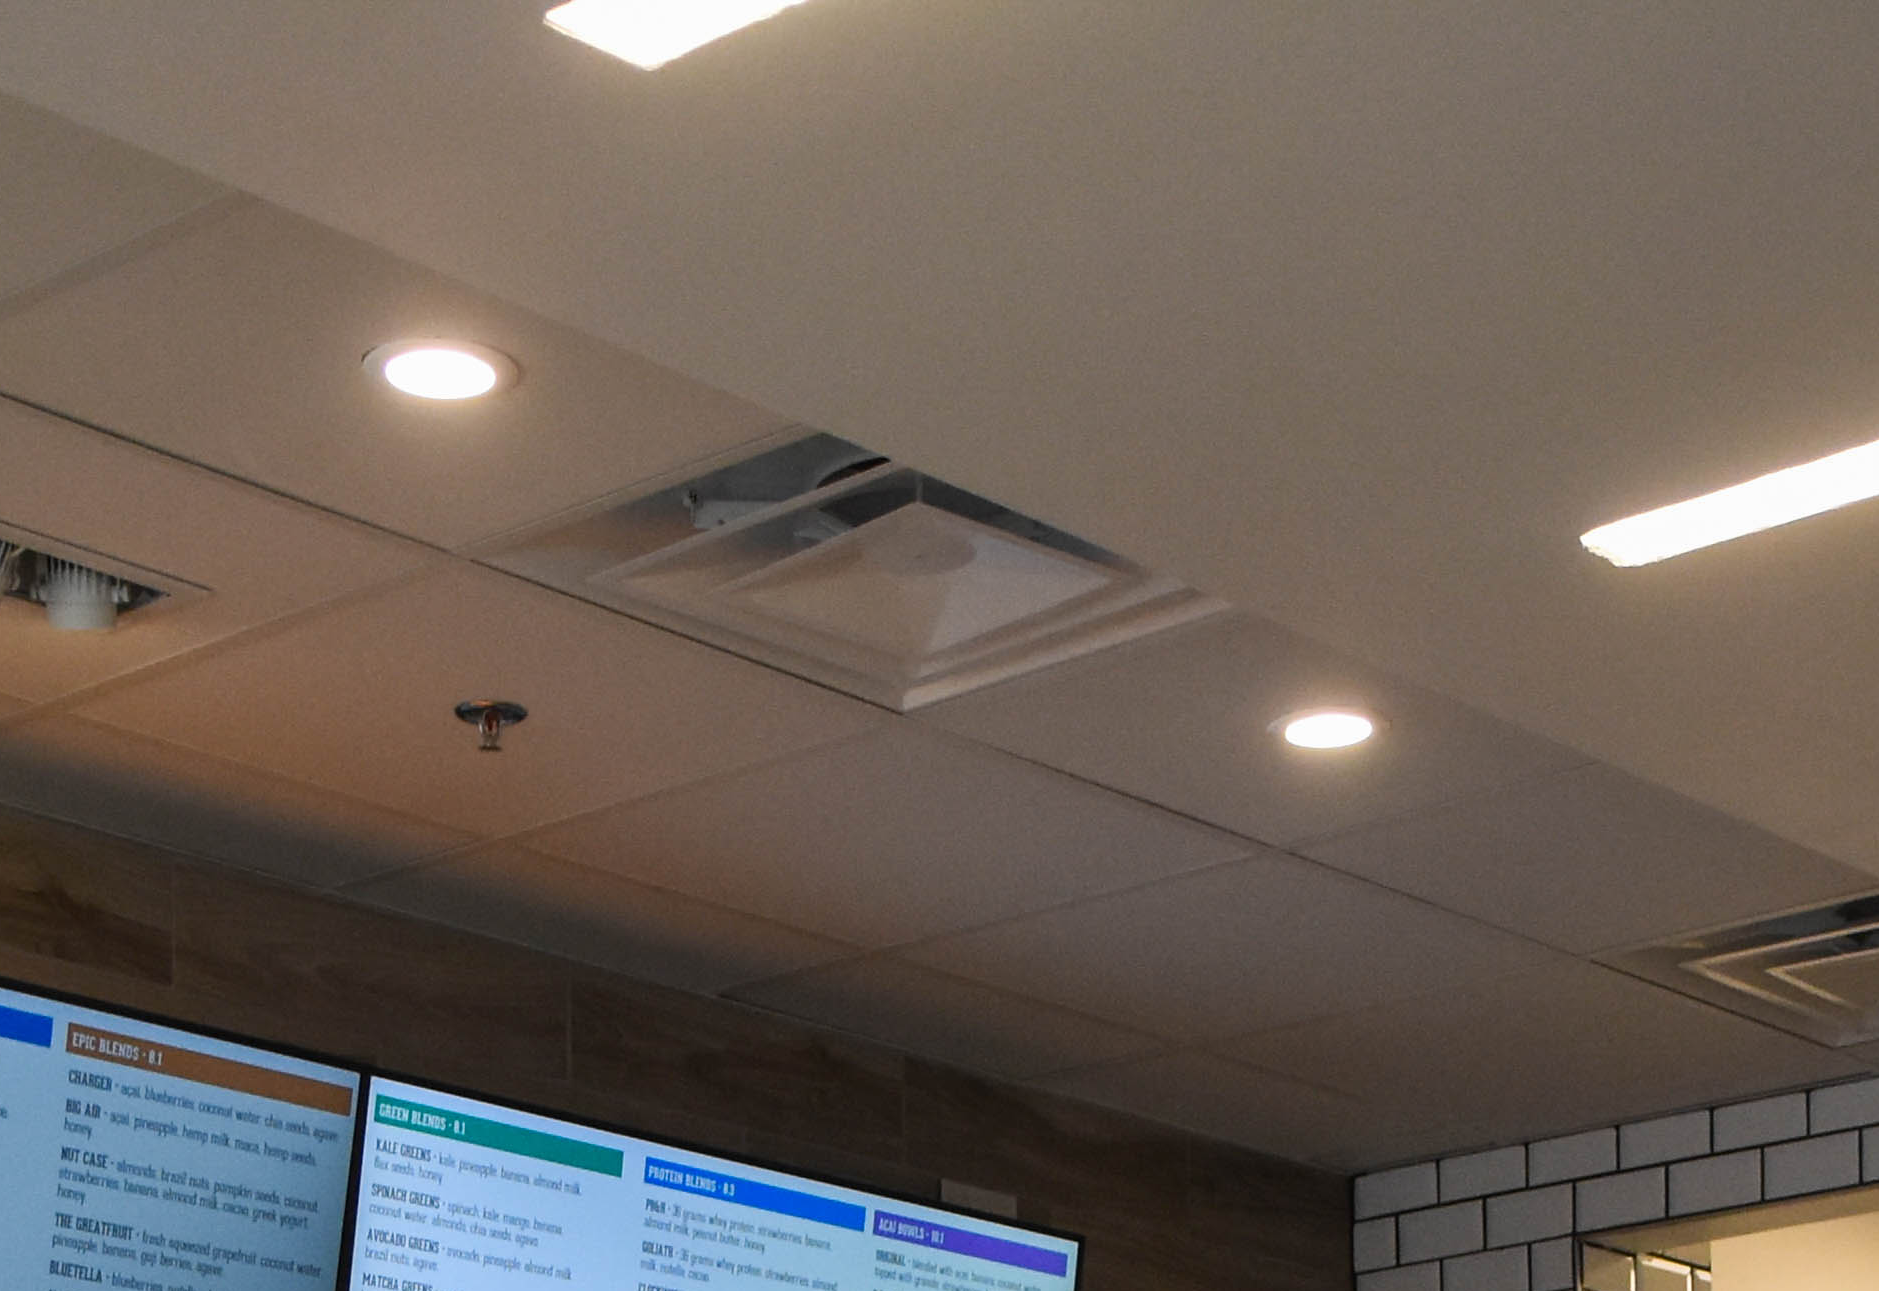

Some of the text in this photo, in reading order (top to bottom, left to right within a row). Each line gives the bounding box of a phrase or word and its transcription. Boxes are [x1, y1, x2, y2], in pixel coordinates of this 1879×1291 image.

[70, 1030, 96, 1052] EPIC
[97, 1036, 140, 1062] BLENDS
[67, 1068, 113, 1093] CHARGER
[64, 1098, 102, 1121] BIG AIR
[377, 1101, 410, 1123] GREEN
[409, 1109, 447, 1131] BLENDS
[59, 1146, 109, 1170] NUT CASE
[374, 1137, 432, 1163] KALE GREENS
[647, 1163, 684, 1186] PROTEIN
[684, 1172, 717, 1193] BLENDS
[370, 1182, 441, 1210] SPINACH GREENS
[53, 1211, 134, 1242] THE GREATFRUIT
[365, 1226, 440, 1255] AVOCADO GREENS
[48, 1259, 104, 1284] BLUETELLA
[361, 1271, 399, 1291] MATCHA
